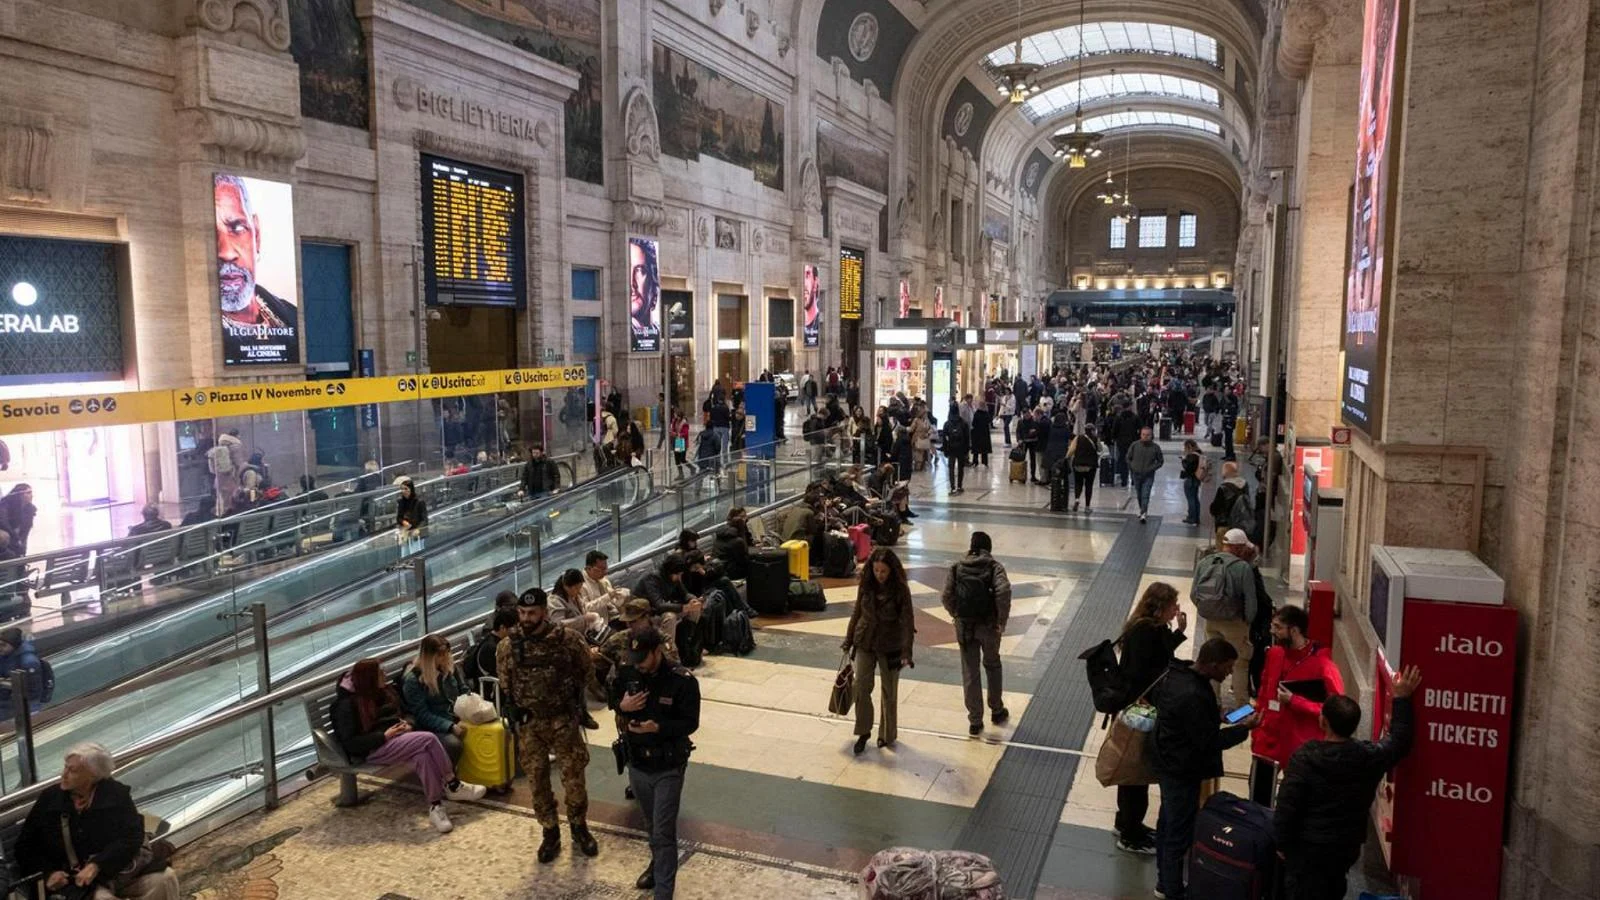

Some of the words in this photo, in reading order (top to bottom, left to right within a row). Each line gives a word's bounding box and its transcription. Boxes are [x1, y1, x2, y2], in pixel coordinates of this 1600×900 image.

[416, 87, 534, 141] BIGLIETTERIA
[240, 327, 294, 336] GLADIATORE
[440, 375, 471, 389] Uscita
[522, 371, 549, 383] Uscita
[209, 391, 248, 403] Piazza
[251, 388, 263, 400] IV
[266, 386, 322, 399] Novembre
[2, 402, 60, 418] Savoia
[1424, 688, 1507, 715] BIGLIETTI
[1428, 722, 1499, 748] TICKETS
